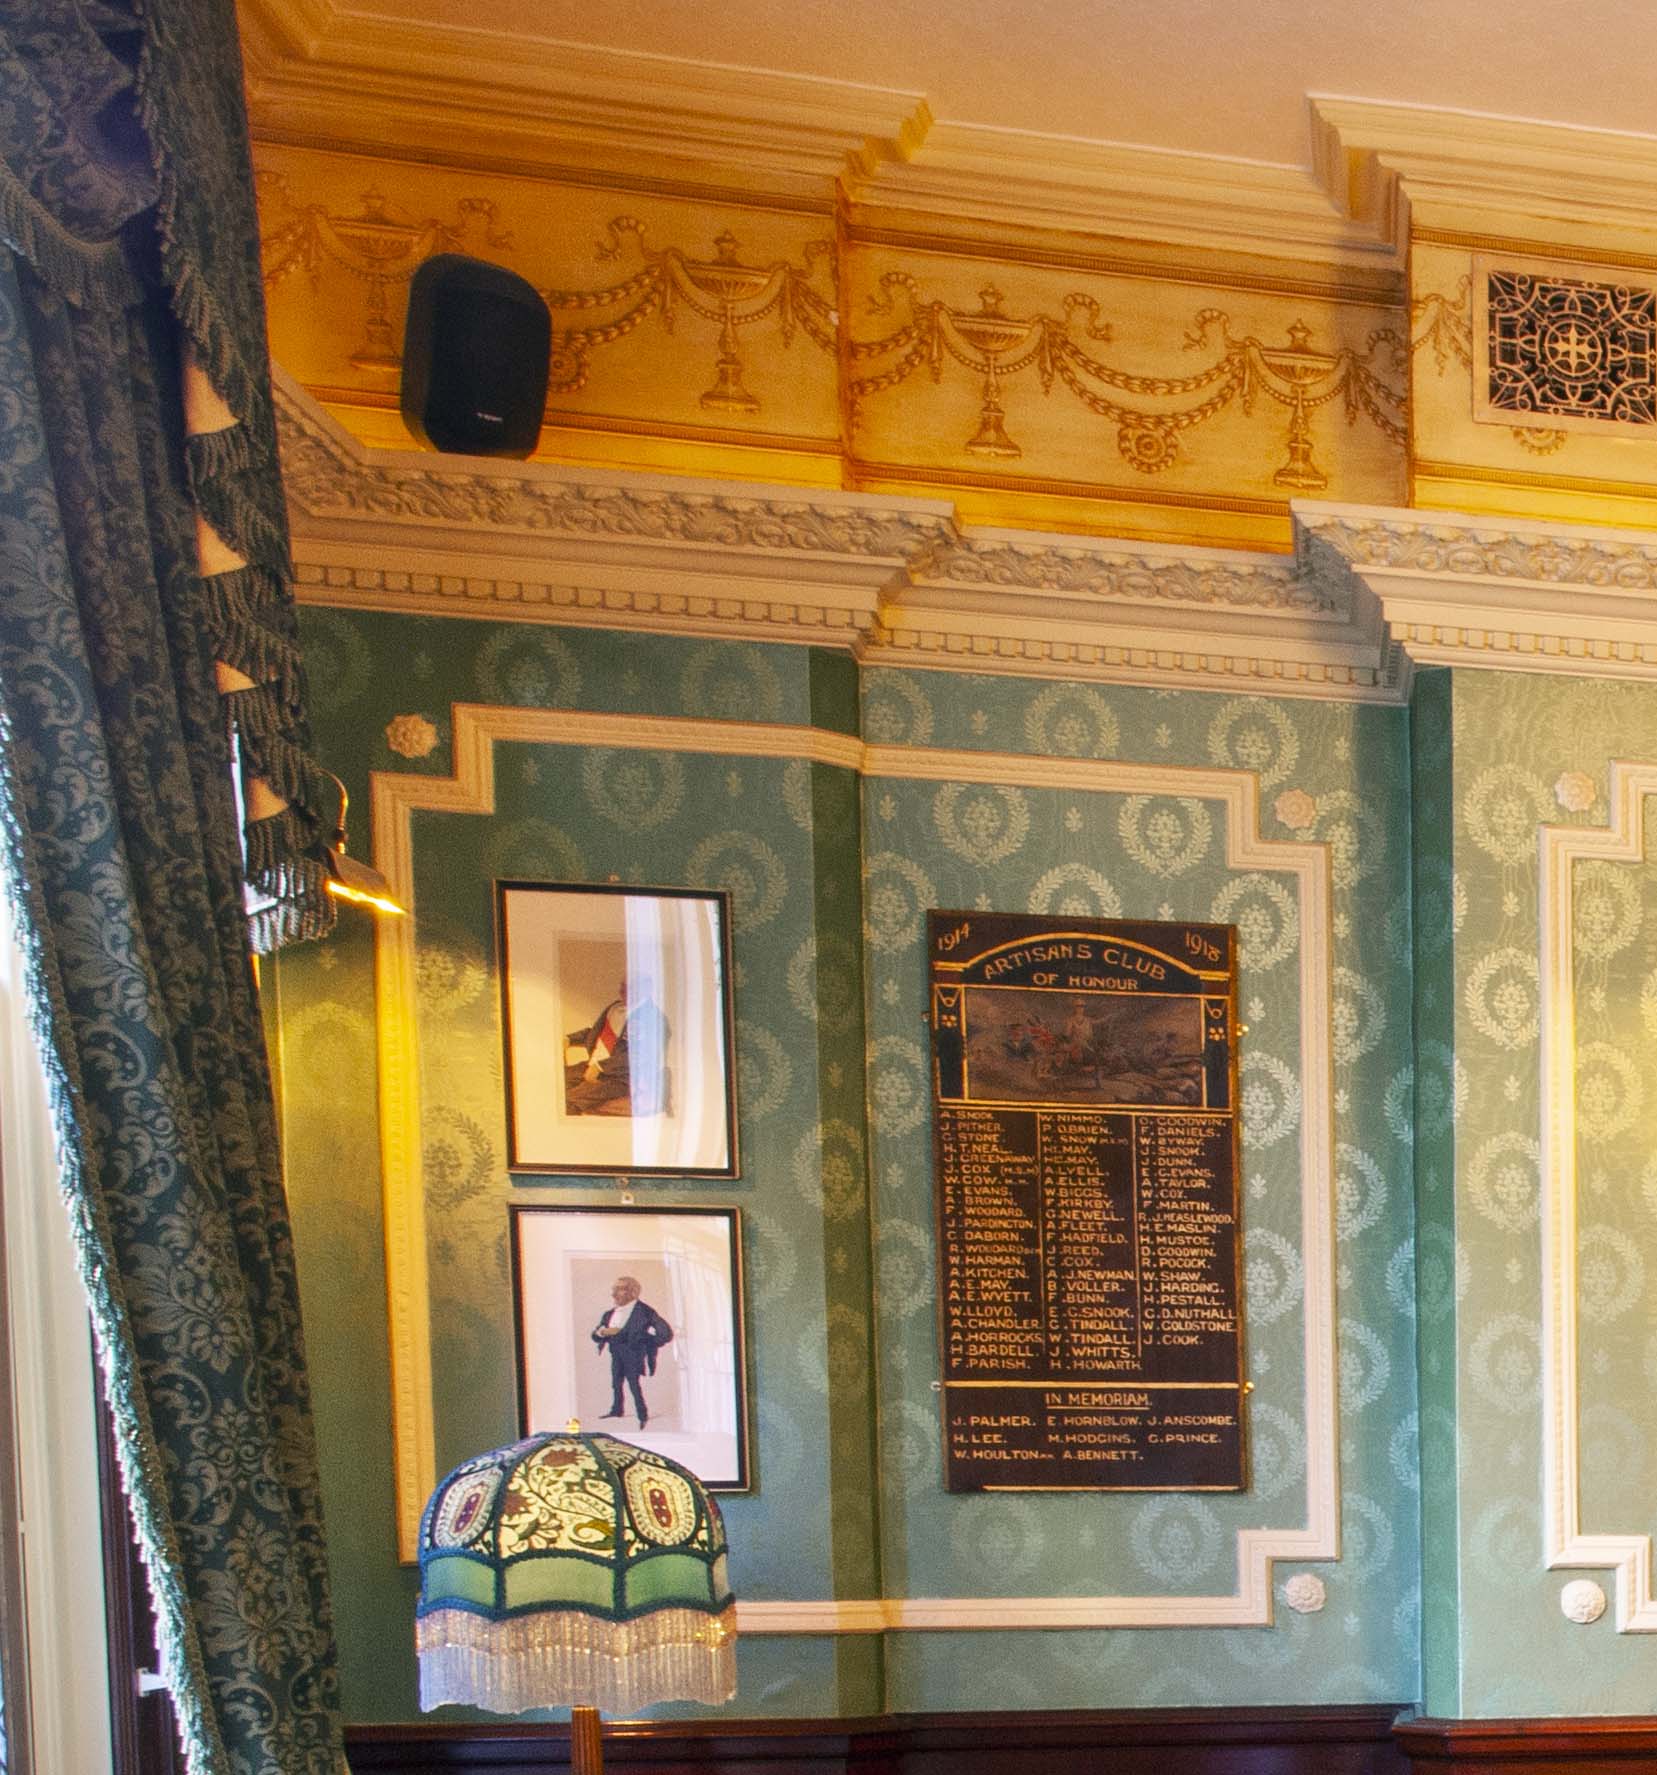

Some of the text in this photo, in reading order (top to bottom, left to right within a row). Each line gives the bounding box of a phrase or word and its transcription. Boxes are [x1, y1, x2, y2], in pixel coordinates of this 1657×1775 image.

[937, 922, 970, 952] 1914
[1184, 930, 1222, 963] 1918
[983, 943, 1167, 982] ARTISANS CLUB
[1032, 972, 1139, 990] OF HONOUR
